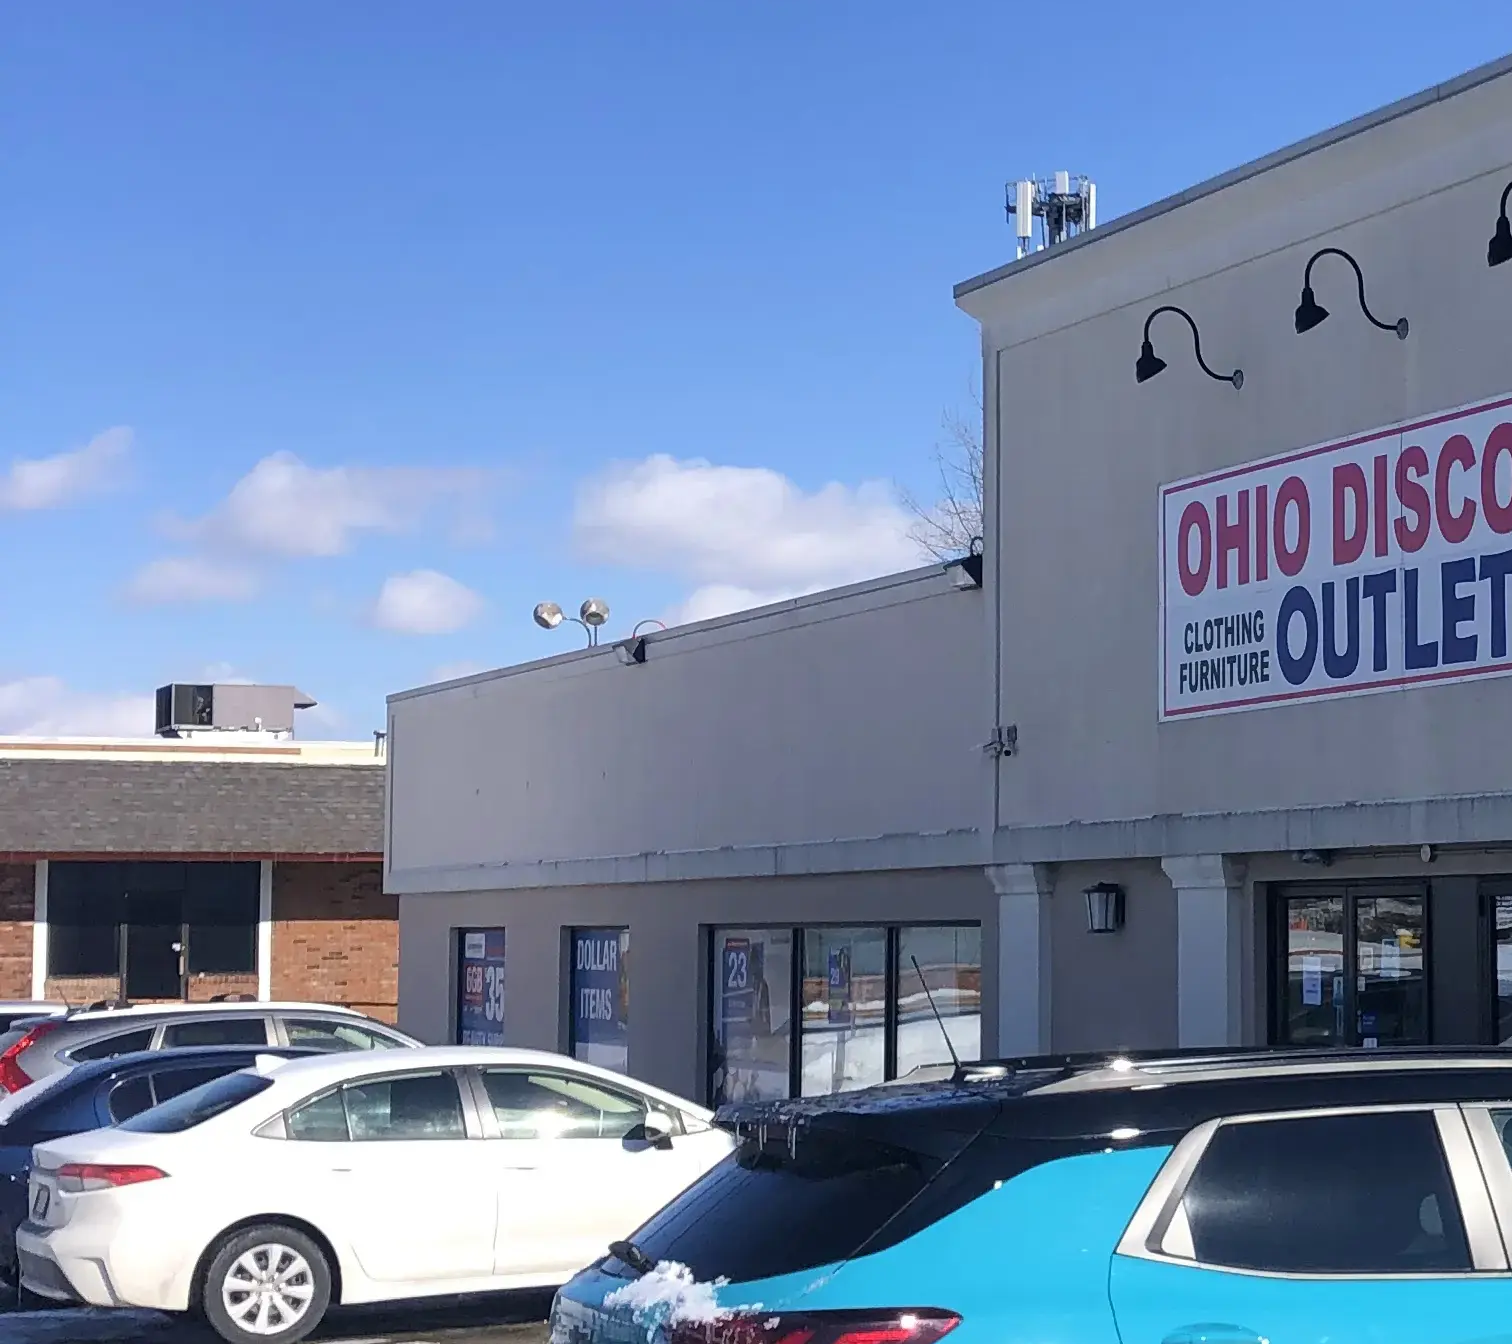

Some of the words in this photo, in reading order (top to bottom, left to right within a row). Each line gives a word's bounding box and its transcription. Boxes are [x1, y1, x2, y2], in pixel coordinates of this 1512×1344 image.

[1178, 476, 1311, 597] OHIO
[1184, 610, 1265, 654] CLOTHING
[1179, 650, 1270, 695] FURNITURE
[577, 939, 617, 971] DOLLAR
[727, 952, 747, 988] 23
[485, 966, 504, 1022] 35
[580, 988, 612, 1020] ITEMS
